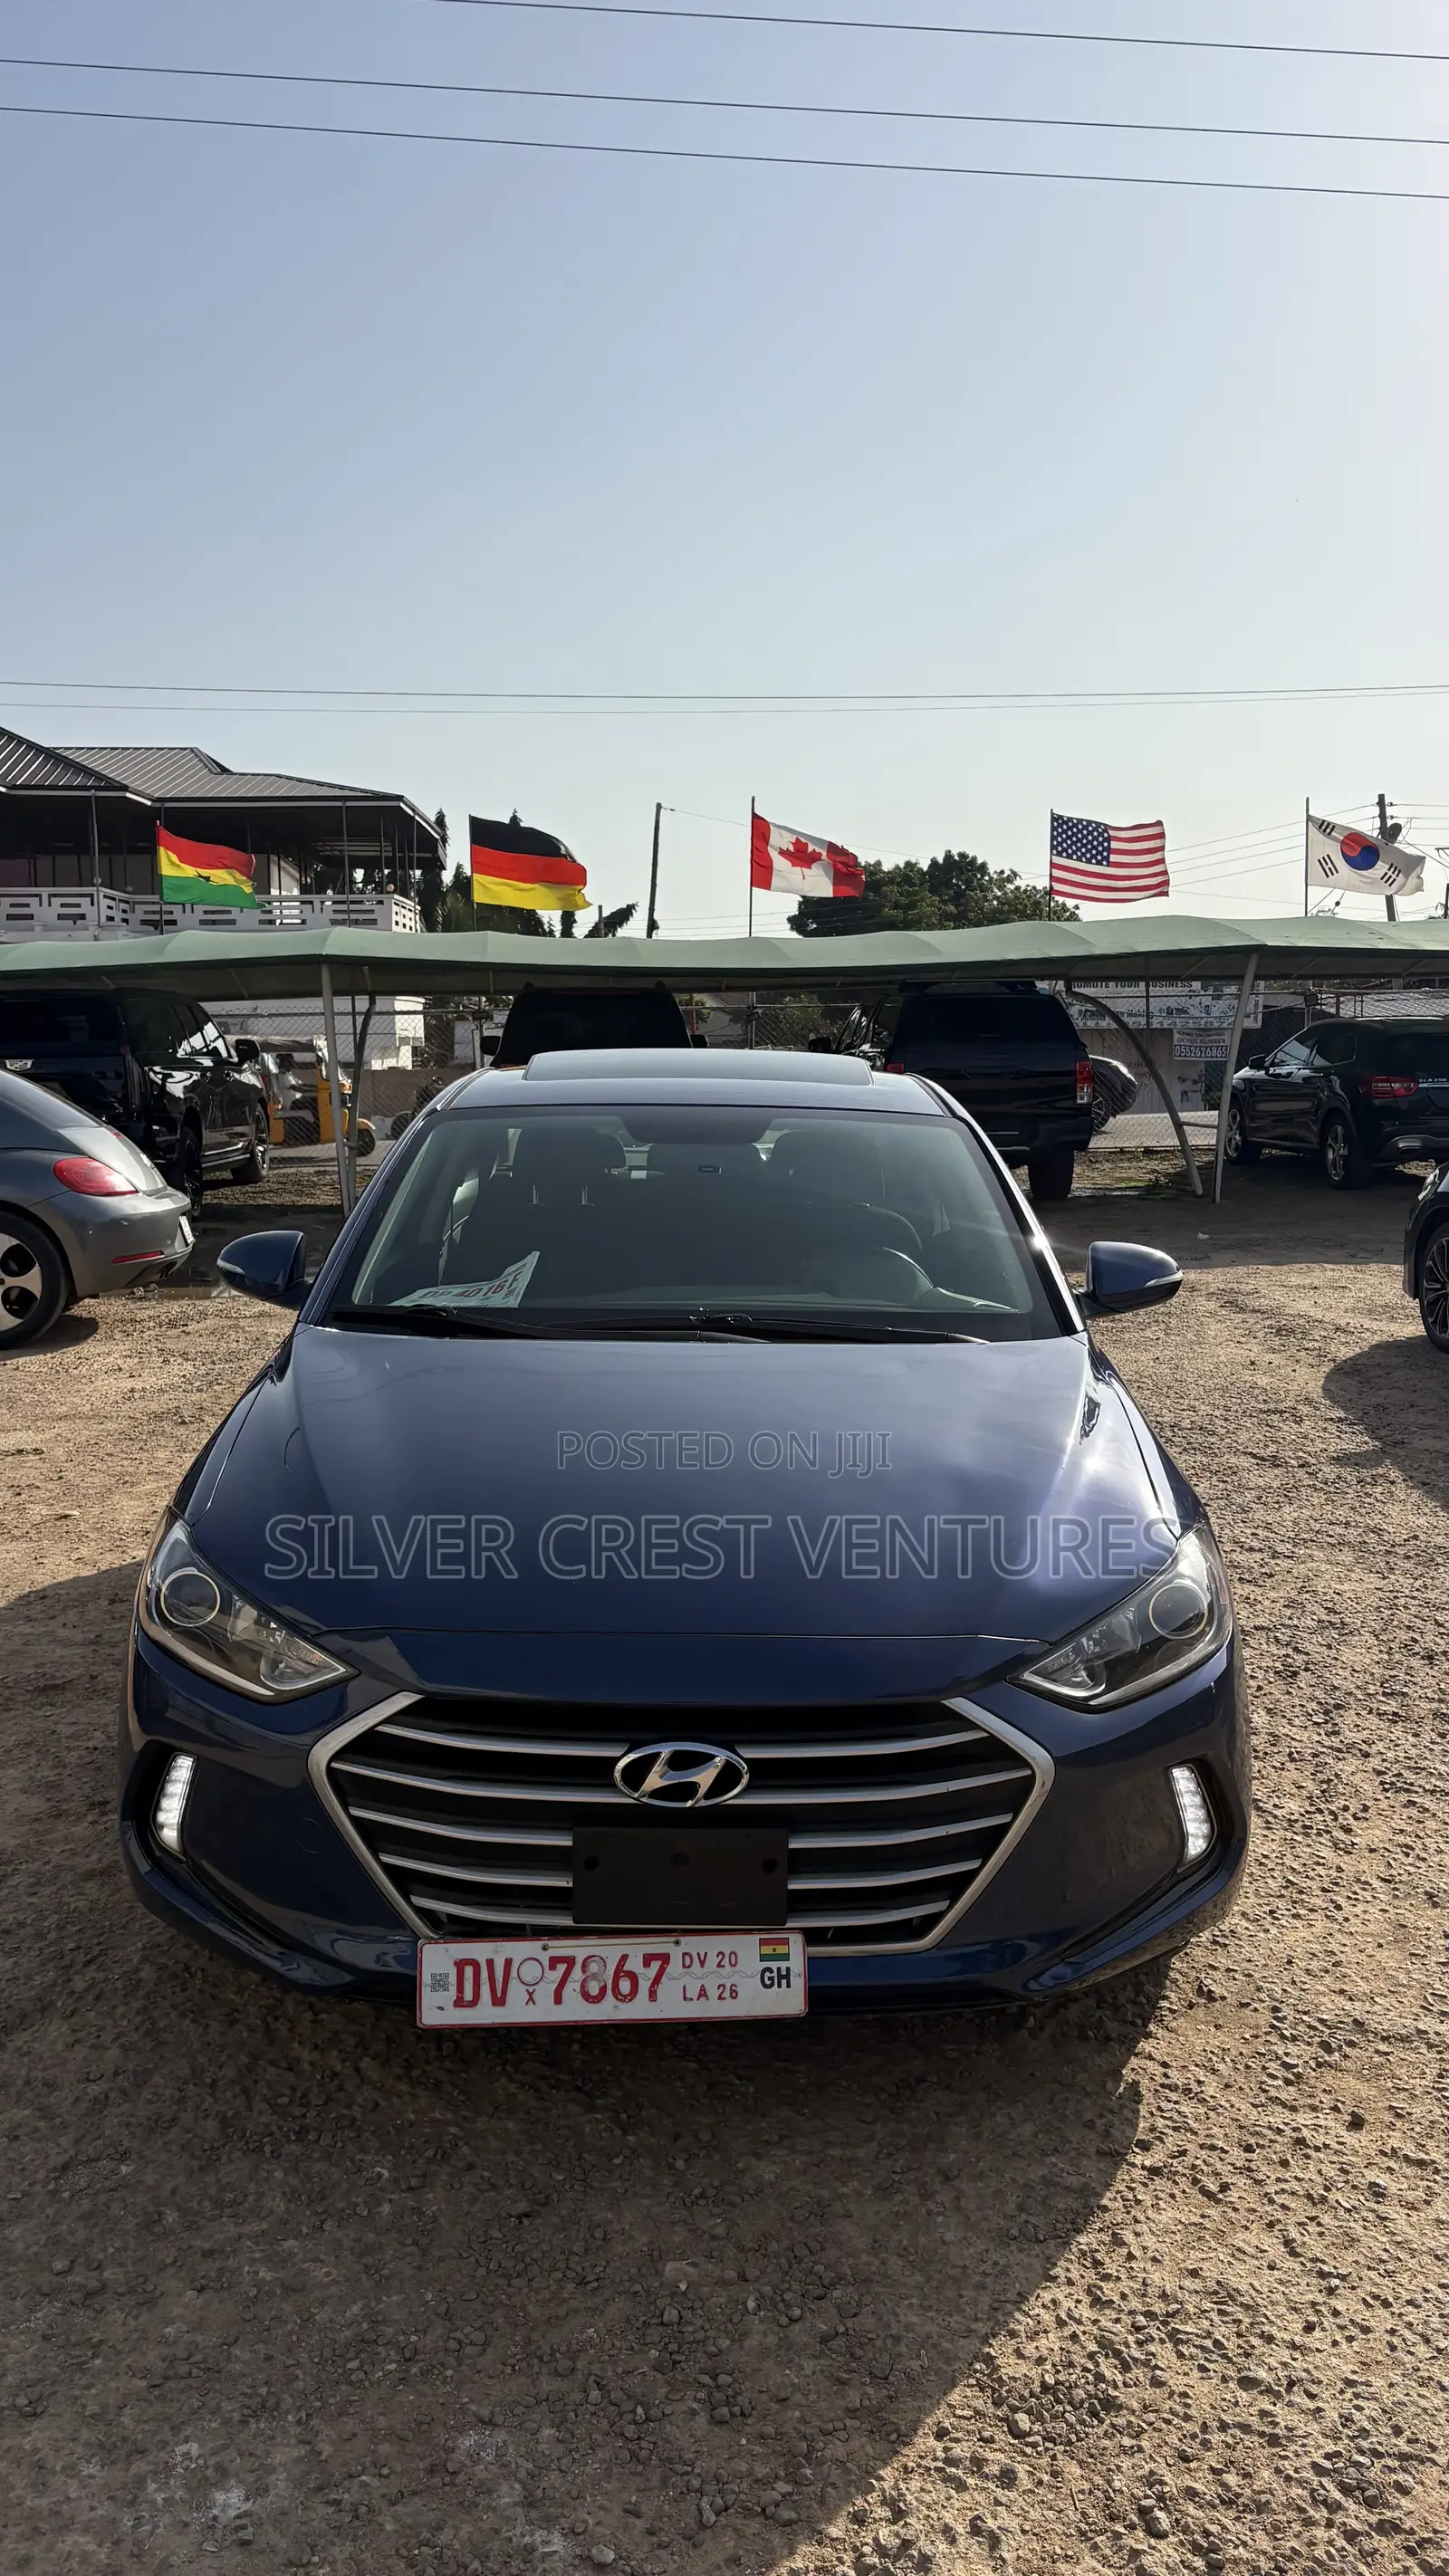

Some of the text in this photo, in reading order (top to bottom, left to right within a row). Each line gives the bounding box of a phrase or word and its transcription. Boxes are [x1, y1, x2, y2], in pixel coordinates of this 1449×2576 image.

[1175, 1046, 1227, 1058] 0552626865
[681, 1950, 739, 1970] DV 20
[453, 1952, 671, 2008] DV 7867
[759, 1966, 792, 1989] GH
[681, 1982, 739, 2002] LA 26
